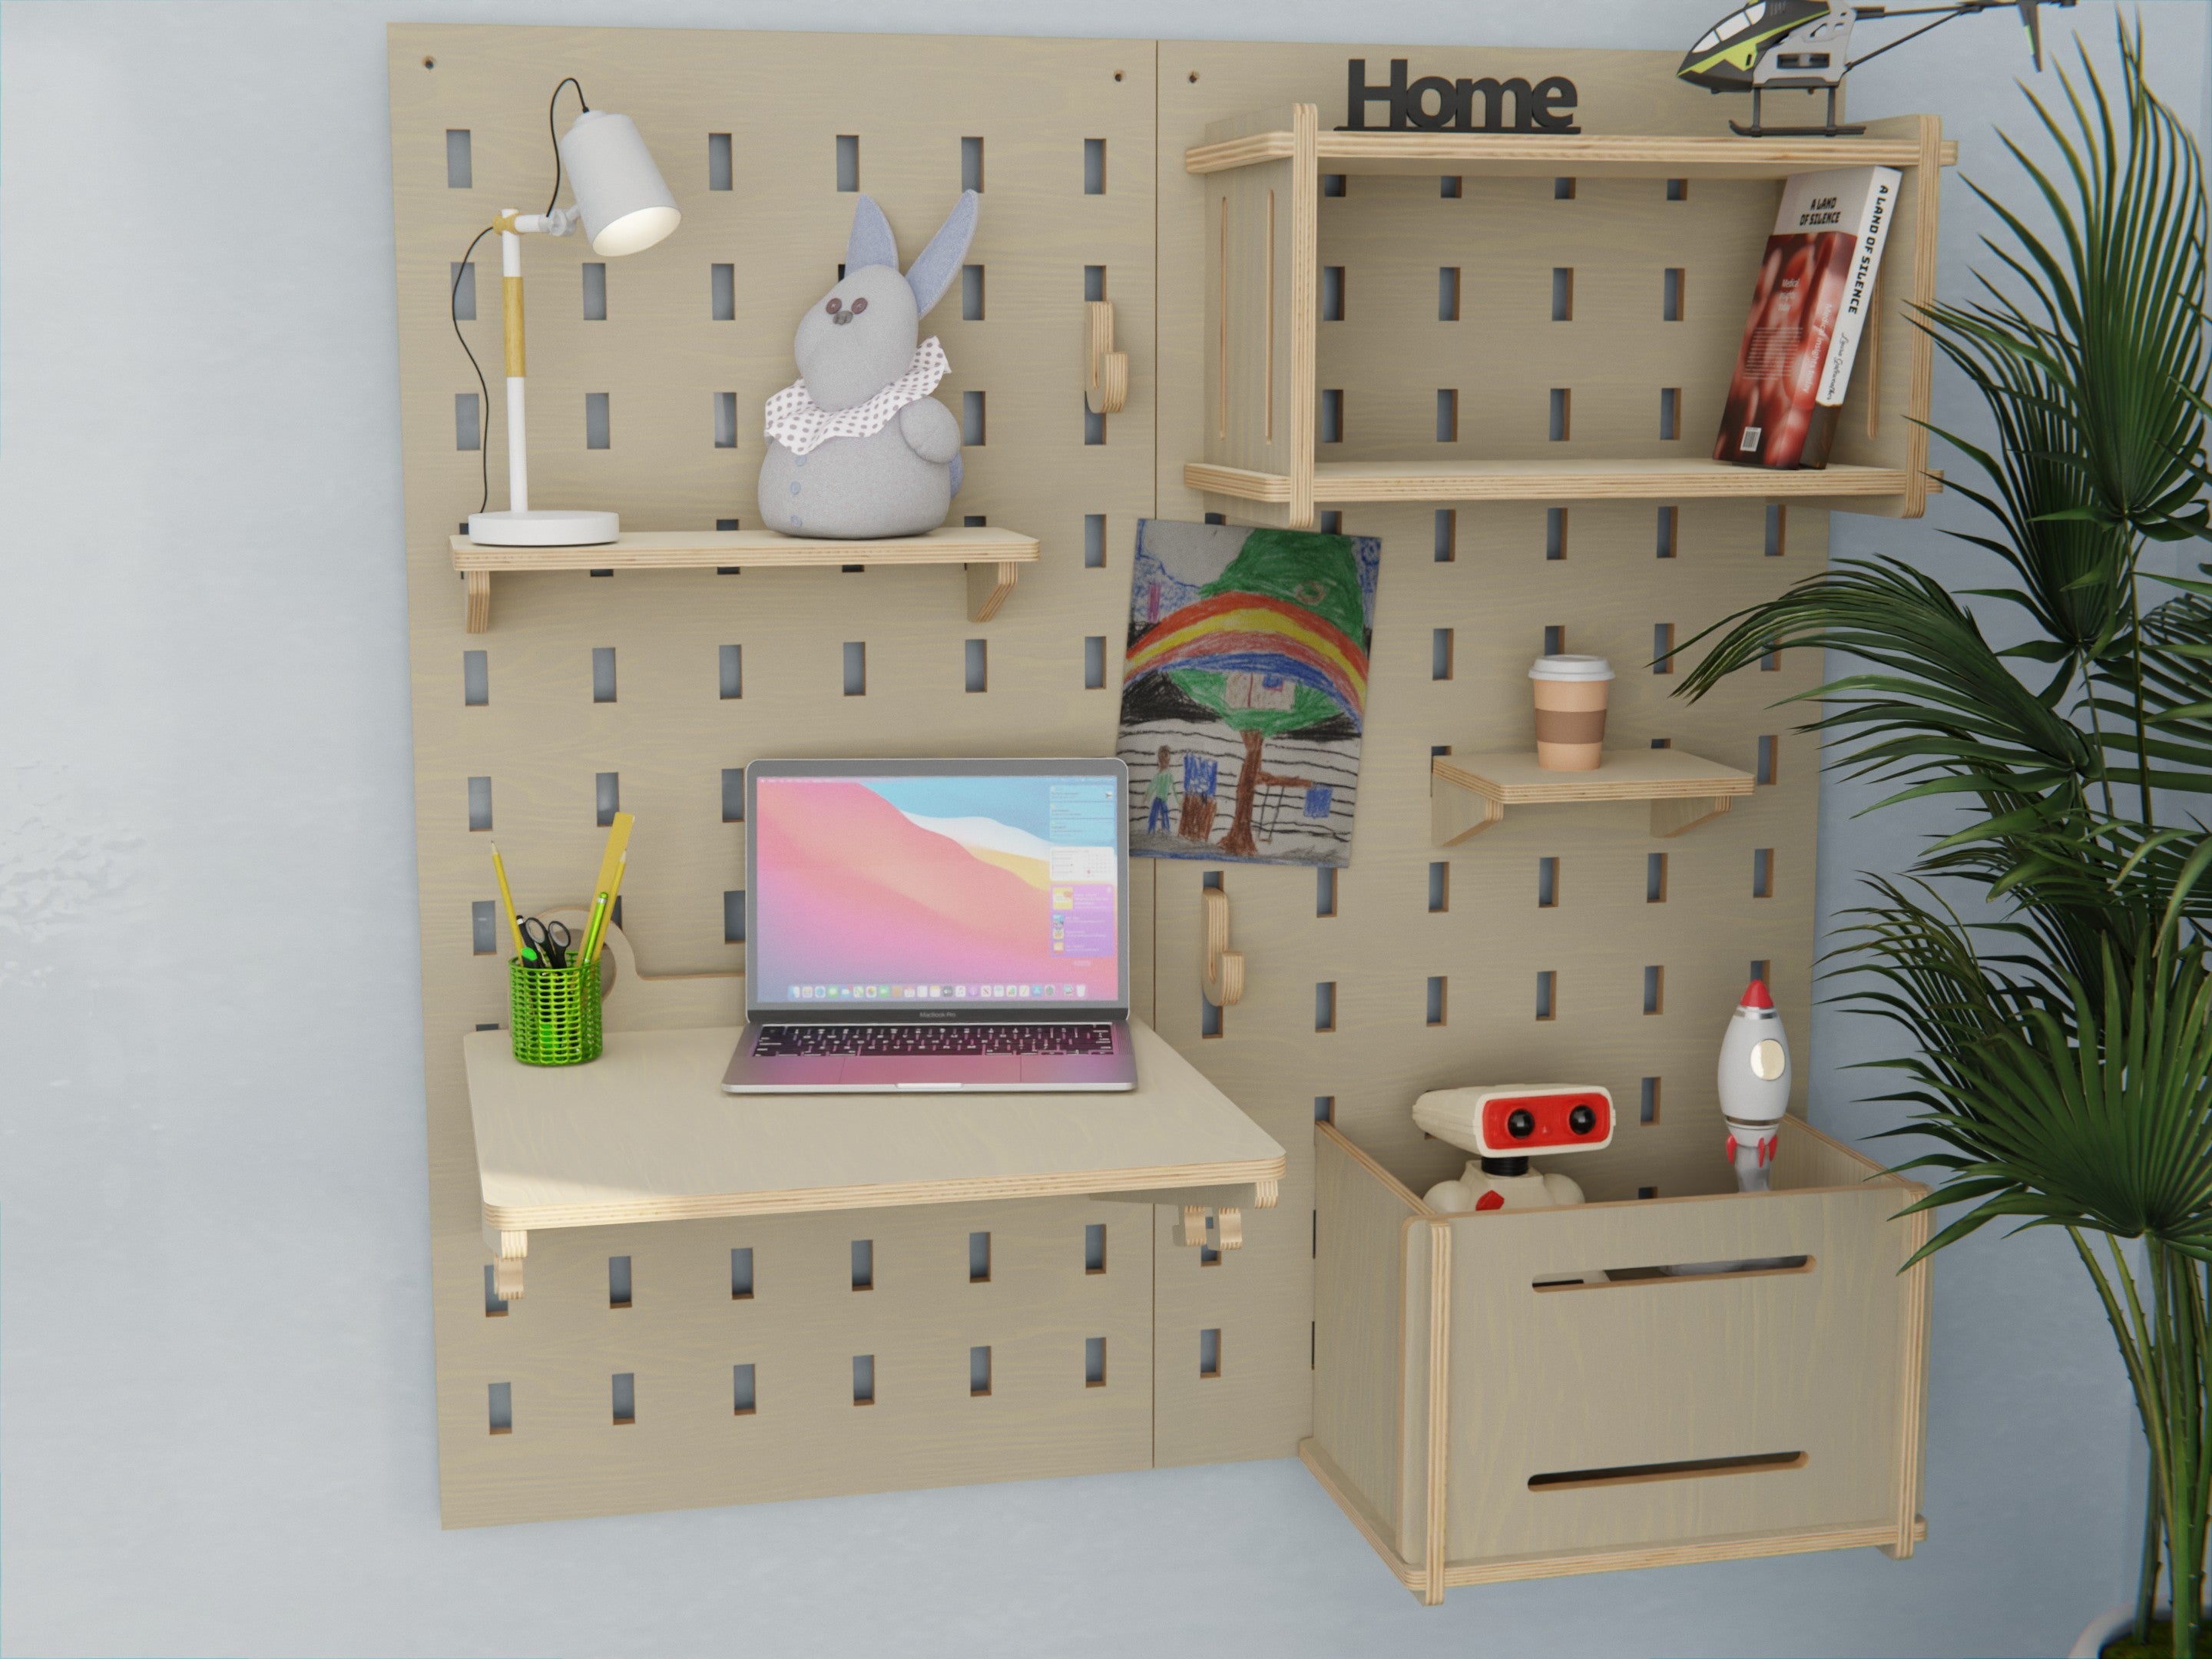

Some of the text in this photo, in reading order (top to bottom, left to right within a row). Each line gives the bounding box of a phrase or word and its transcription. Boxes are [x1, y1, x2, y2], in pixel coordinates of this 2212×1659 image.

[1348, 58, 1578, 129] Home
[1800, 211, 1842, 226] OF SILENCE
[1810, 197, 1837, 210] A LAND
[1848, 184, 1889, 315] A LAND OF SILENCE
